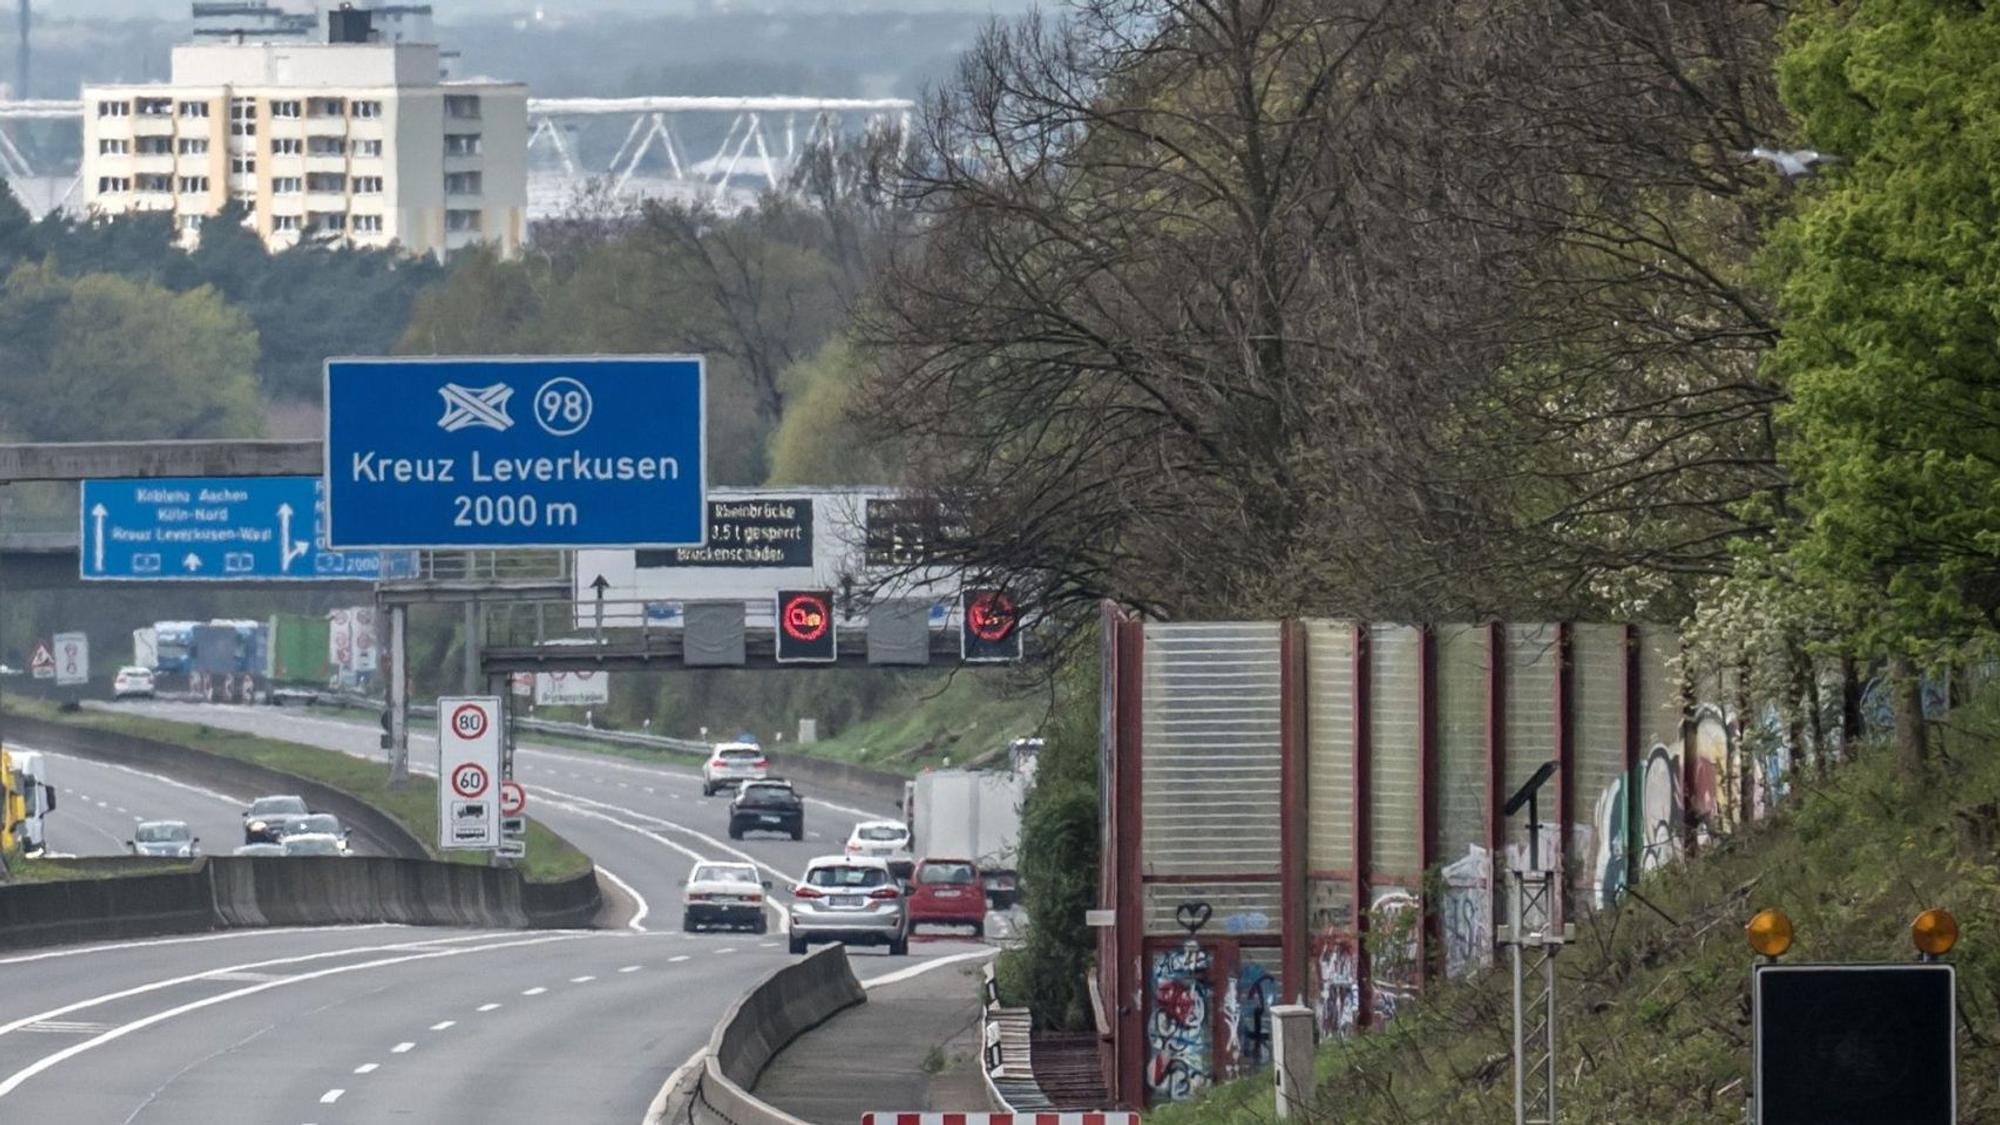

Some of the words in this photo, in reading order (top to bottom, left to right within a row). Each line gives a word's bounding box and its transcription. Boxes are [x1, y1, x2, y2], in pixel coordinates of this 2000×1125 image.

[543, 390, 583, 422] 98
[352, 451, 454, 482] Kreuz
[472, 449, 679, 482] Leverkusen
[199, 488, 248, 502] Aachen
[158, 507, 229, 522] Köln-Nord
[454, 494, 537, 526] 2000
[546, 500, 577, 525] m
[715, 503, 796, 519] Rheinbrücke
[744, 524, 802, 542] gesperrt
[459, 714, 481, 731] 80
[460, 772, 481, 789] 60
